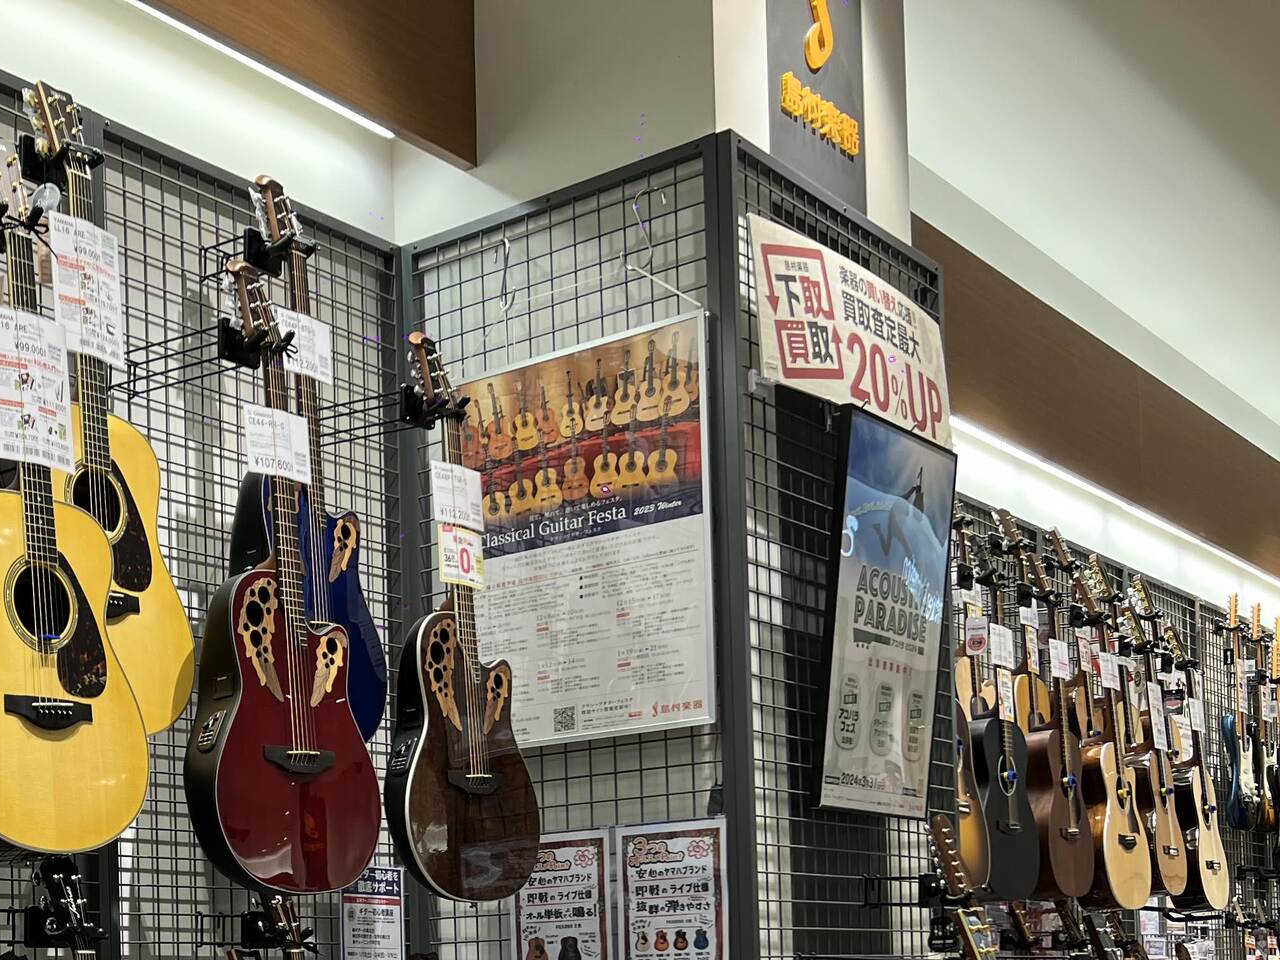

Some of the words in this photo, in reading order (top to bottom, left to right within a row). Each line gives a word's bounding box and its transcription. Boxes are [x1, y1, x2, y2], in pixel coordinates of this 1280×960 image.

[842, 290, 921, 363] 買取査定最大
[847, 332, 942, 440] 20%UP
[539, 513, 584, 536] Guitar
[588, 505, 626, 526] Festa
[633, 504, 655, 516] 2023
[656, 500, 682, 511] Winter
[854, 595, 926, 643] PARADISE
[636, 865, 707, 878] 安心のヤマハブランド
[636, 900, 711, 914] 抜群の弾きやすさ
